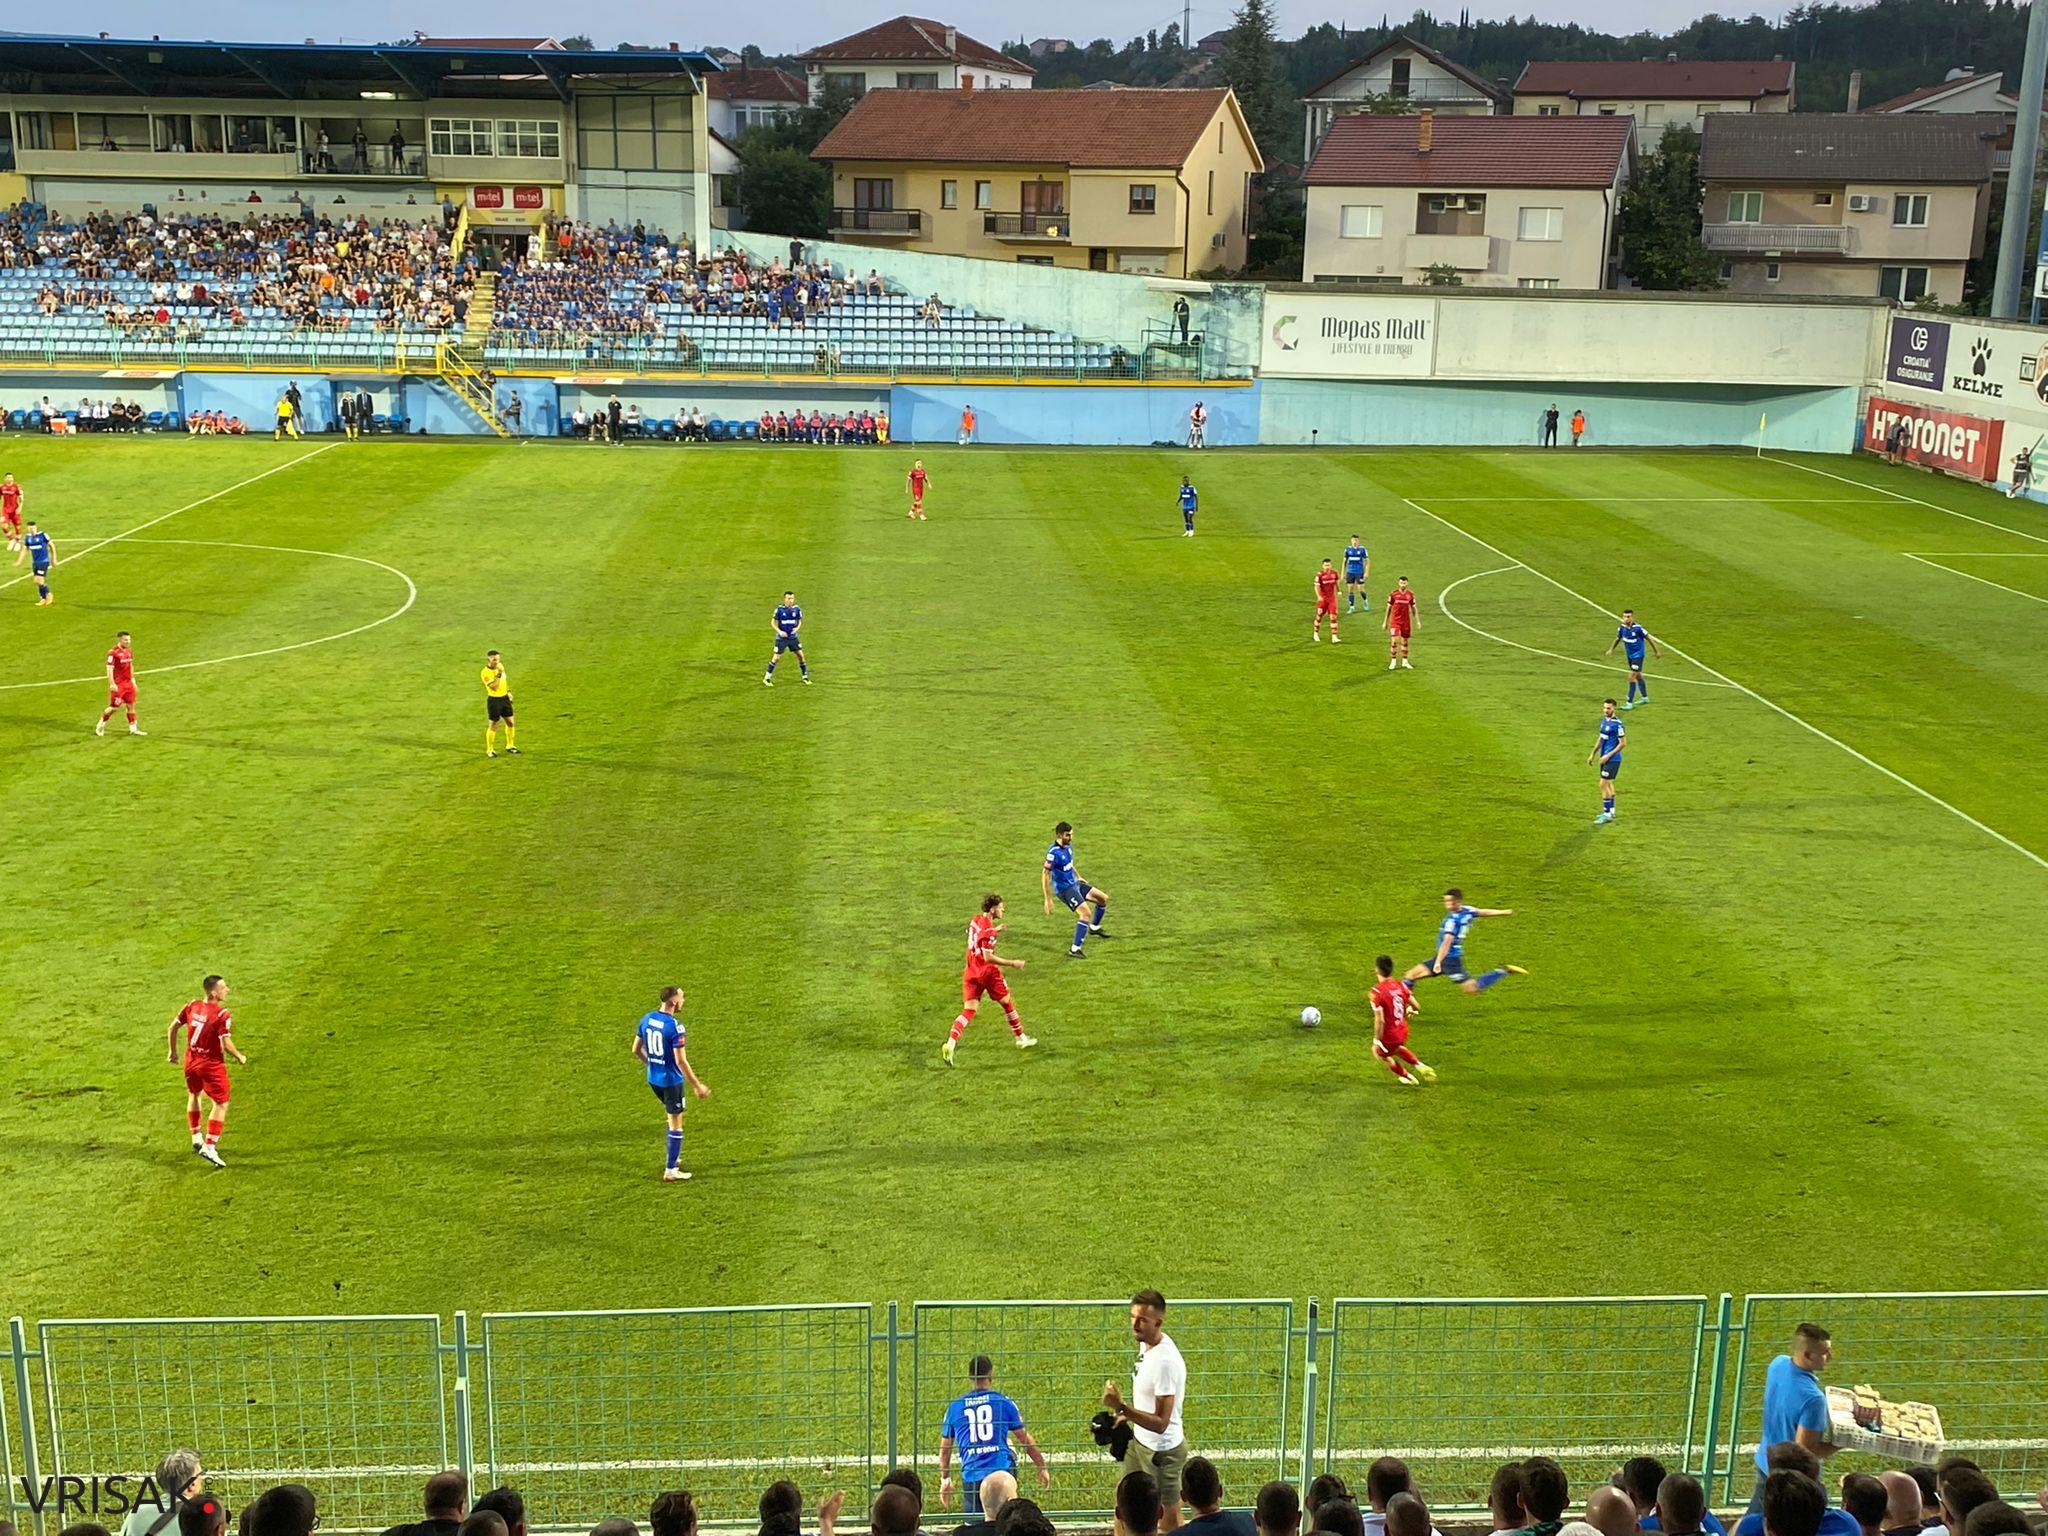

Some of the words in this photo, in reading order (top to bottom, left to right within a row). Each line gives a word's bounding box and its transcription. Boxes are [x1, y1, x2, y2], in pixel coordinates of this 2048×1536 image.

[1321, 317, 1380, 341] Mepas
[1386, 318, 1425, 340] Mall
[1903, 355, 1930, 368] CROATIA
[1896, 367, 1935, 382] OSIGURANJE
[1953, 376, 2004, 398] KELME
[190, 1022, 205, 1046] 7
[645, 1028, 664, 1057] 10
[963, 1404, 994, 1443] 18
